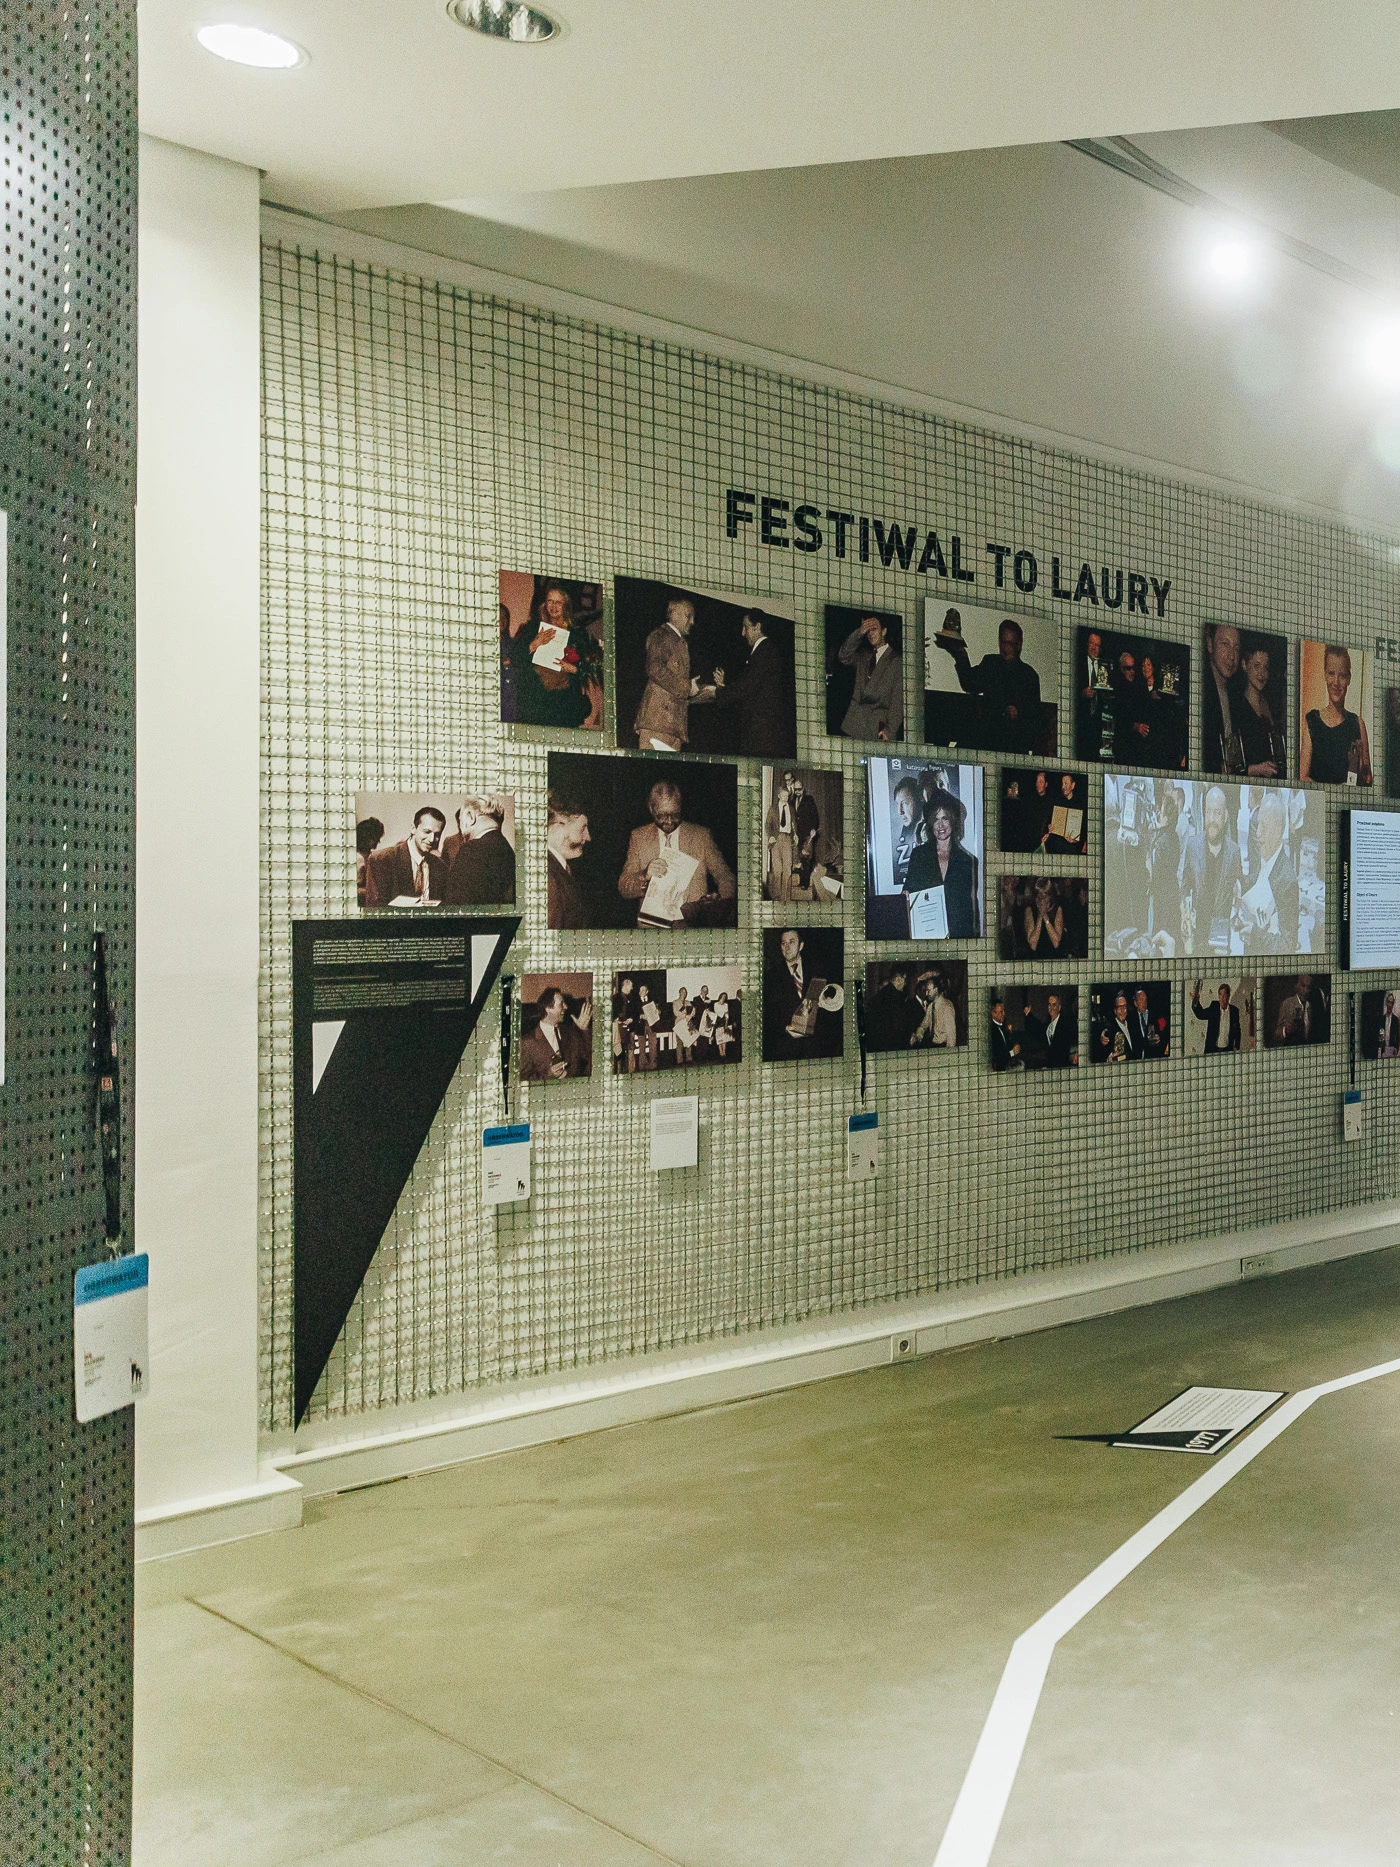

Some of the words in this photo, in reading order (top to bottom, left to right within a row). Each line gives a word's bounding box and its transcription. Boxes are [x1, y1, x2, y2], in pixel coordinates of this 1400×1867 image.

[726, 489, 974, 582] FESTIWAL
[987, 543, 1038, 593] TO
[1051, 557, 1172, 618] LAURY
[1343, 882, 1349, 890] TO
[1185, 1430, 1220, 1449] 1977
